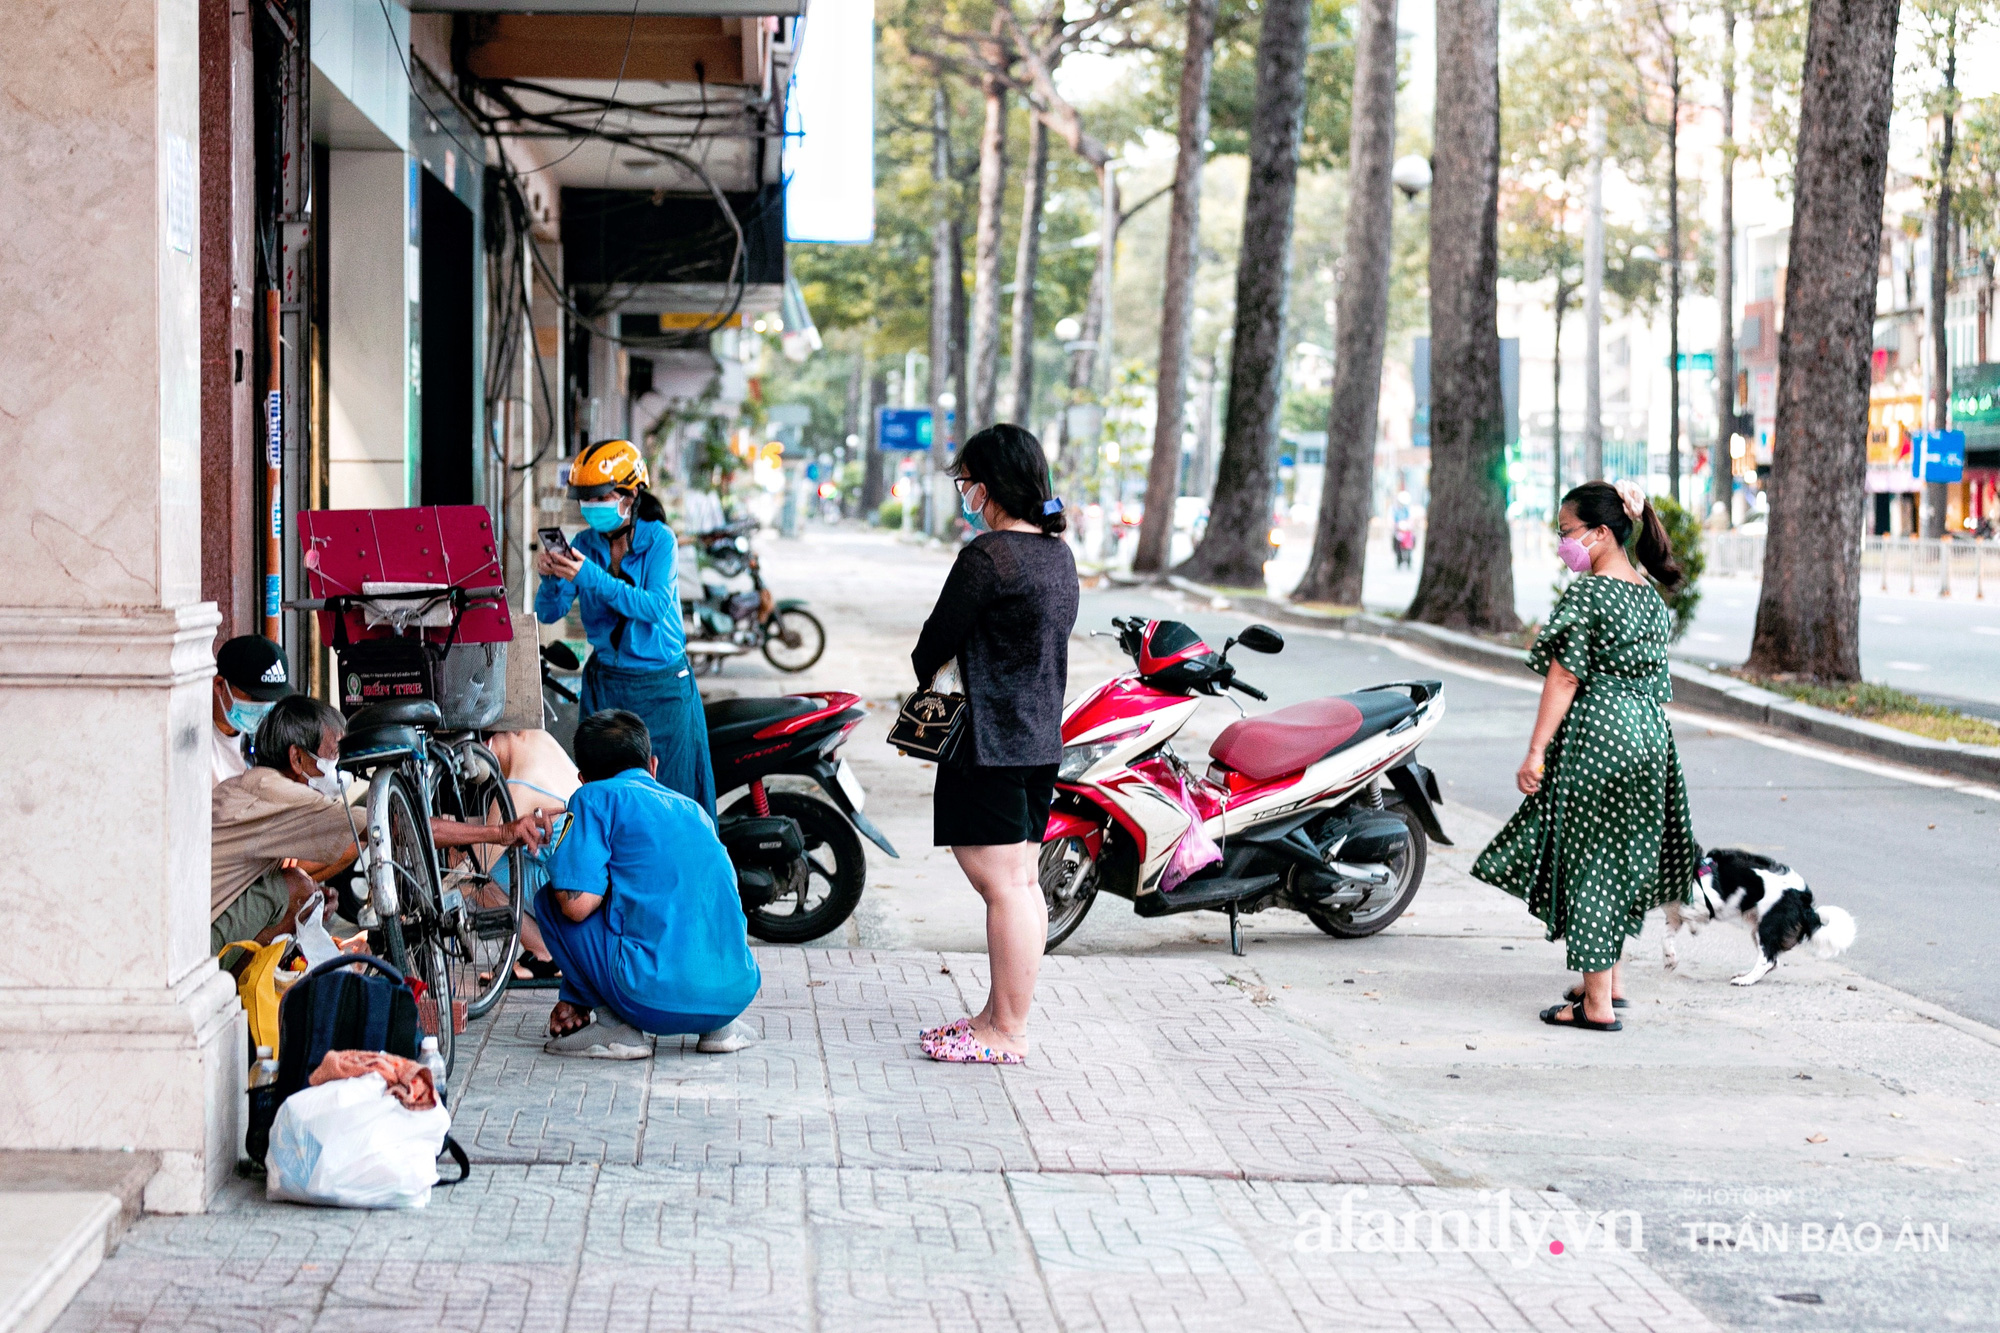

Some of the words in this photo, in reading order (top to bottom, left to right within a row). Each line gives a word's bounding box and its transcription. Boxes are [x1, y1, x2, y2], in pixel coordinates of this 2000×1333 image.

[261, 674, 287, 682] adidas
[363, 680, 390, 697] BẾN
[393, 682, 423, 696] TRE
